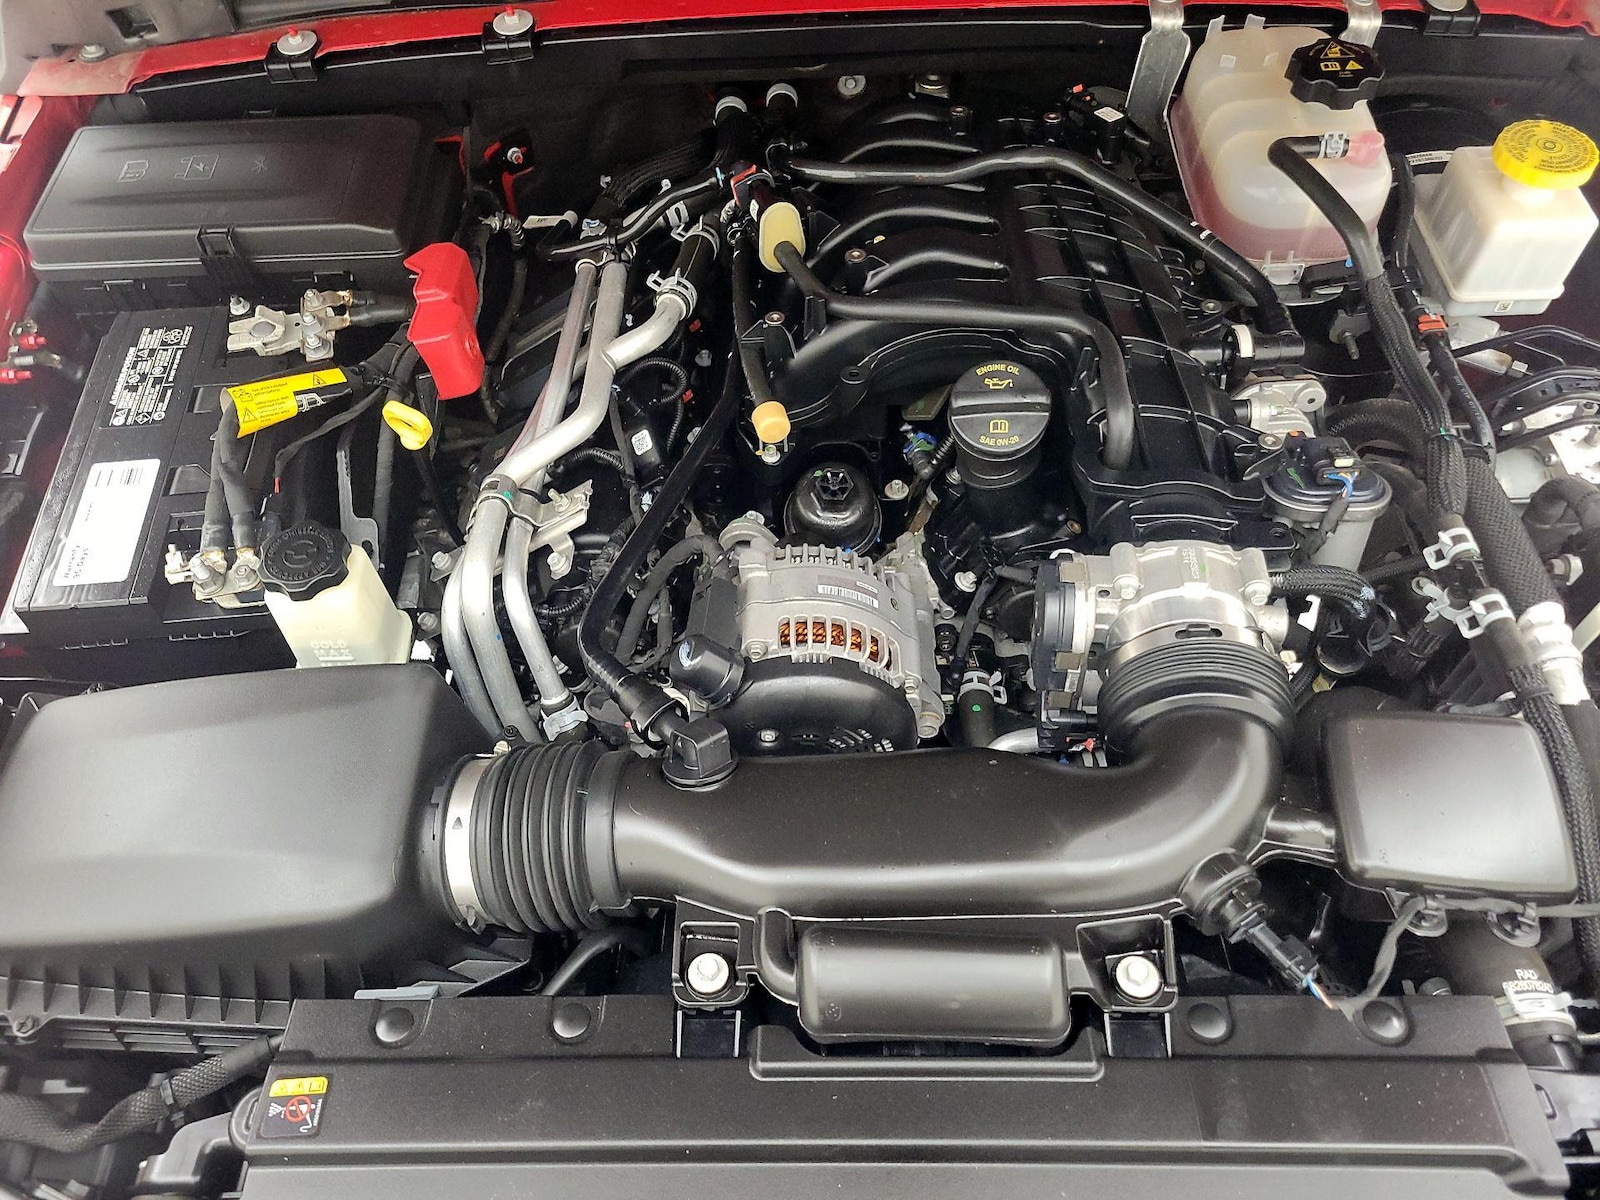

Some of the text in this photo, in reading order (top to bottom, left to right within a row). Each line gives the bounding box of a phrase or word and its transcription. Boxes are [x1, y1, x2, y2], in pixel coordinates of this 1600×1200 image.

[976, 363, 1020, 376] ENGINE OIL
[979, 435, 1020, 446] SAE 0W-20
[311, 640, 348, 649] COLD
[313, 648, 352, 657] MAX
[1515, 969, 1538, 980] RAD
